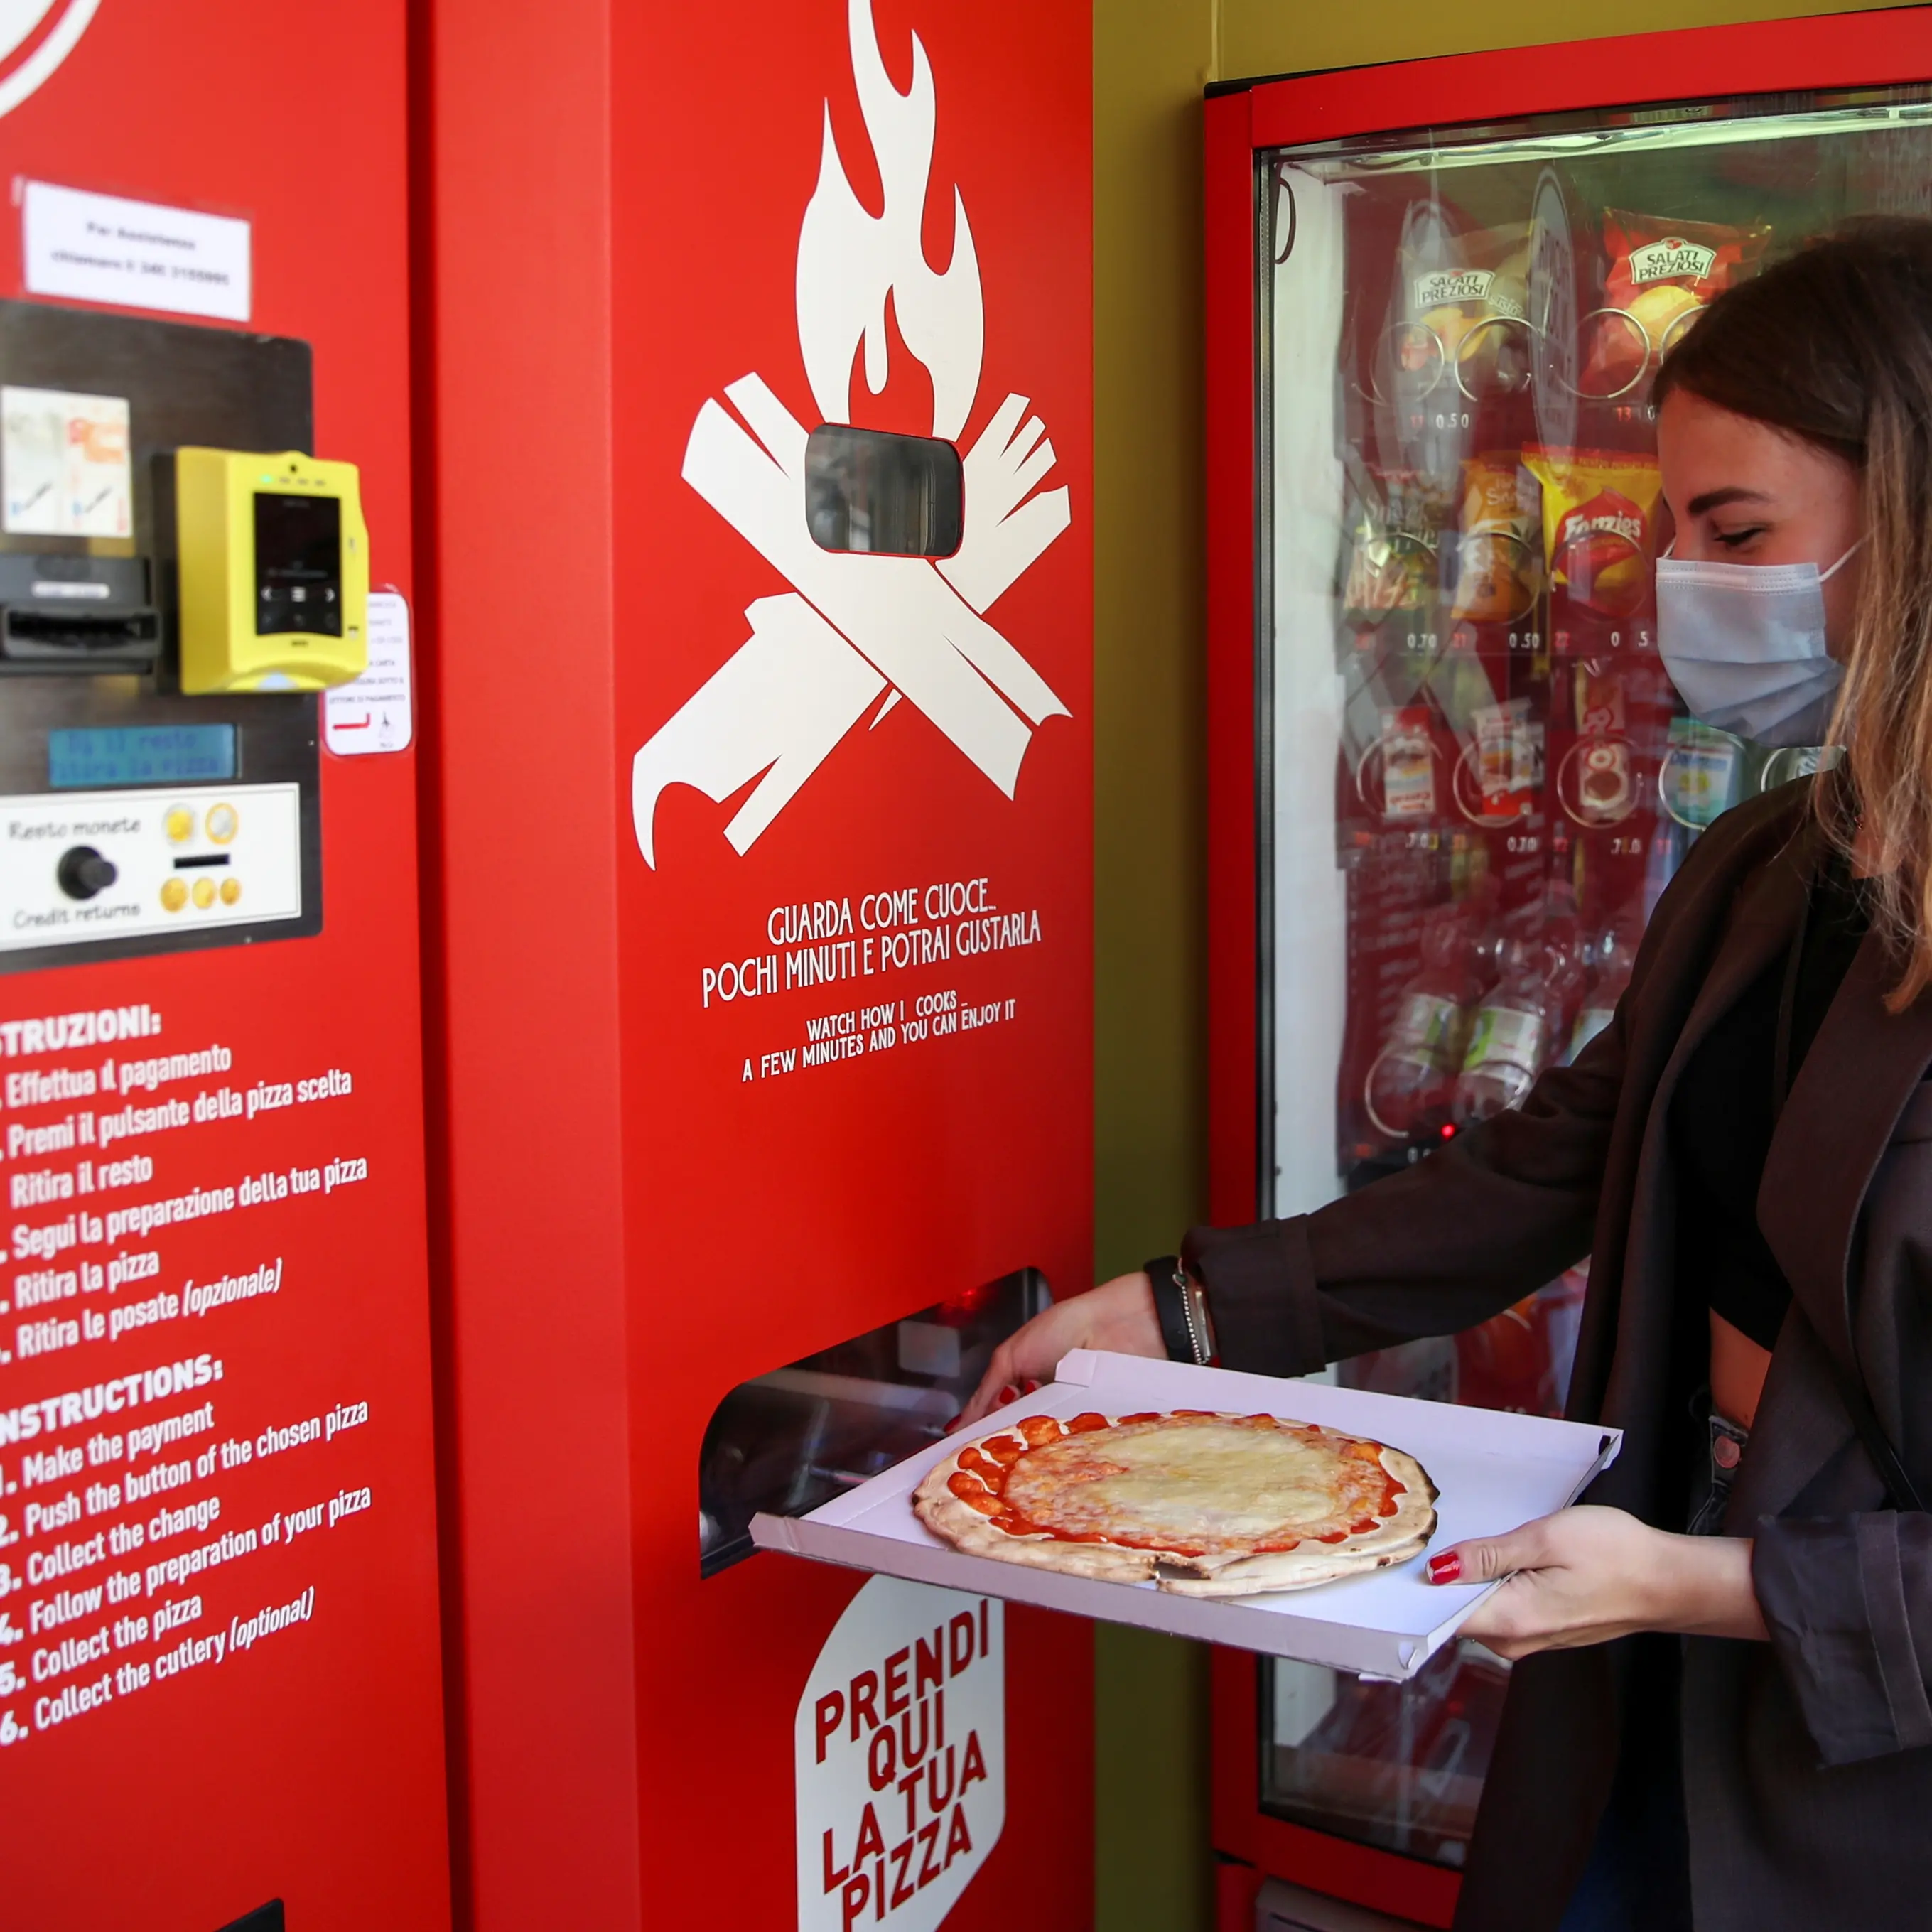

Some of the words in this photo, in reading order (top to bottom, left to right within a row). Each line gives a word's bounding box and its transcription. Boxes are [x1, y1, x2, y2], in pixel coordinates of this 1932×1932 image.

[1422, 284, 1484, 303] PREZIOSI
[1430, 275, 1478, 286] SALATI
[1639, 261, 1705, 279] PREZIOSI
[1647, 251, 1698, 265] SALATI
[1564, 510, 1641, 541] Fonzies
[9, 821, 68, 840] Resto
[72, 816, 141, 836] monete
[14, 907, 70, 929] Credit
[702, 954, 777, 1008] POCHI
[785, 940, 856, 990] MINUTI
[863, 938, 874, 975] E
[881, 925, 950, 972] POTRAI
[956, 910, 1041, 956] GUSTARLA
[767, 898, 853, 945] GUARDA
[860, 888, 919, 931] COME
[742, 1059, 753, 1082] A
[761, 1049, 797, 1079] FEW
[802, 1035, 864, 1069] MINUTES
[869, 1027, 896, 1052] AND
[901, 1020, 928, 1045] YOU
[933, 1012, 957, 1037] CAN
[961, 1003, 1002, 1030] ENJOY
[1005, 999, 1016, 1021] IT
[806, 1013, 856, 1042] WATCH
[861, 1003, 895, 1029] HOW
[915, 990, 957, 1018] COOKS
[6, 1068, 96, 1108] Effettua
[101, 1060, 116, 1091] il
[121, 1044, 232, 1096] pagamento
[7, 1116, 73, 1159] Premi
[79, 1111, 95, 1145] il
[100, 1098, 189, 1148] pulsante
[194, 1087, 242, 1123] della
[247, 1080, 293, 1119] pizza
[298, 1069, 352, 1103] scelta
[10, 1169, 72, 1209] Ritira
[78, 1163, 94, 1194] il
[100, 1155, 153, 1190] resto
[12, 1211, 76, 1261] Segui
[81, 1210, 101, 1243] la
[107, 1185, 234, 1246] preparazione
[239, 1174, 287, 1207] della
[291, 1168, 320, 1195] tua
[325, 1157, 367, 1195] pizza
[15, 1268, 77, 1310] Ritira
[82, 1262, 101, 1291] la
[109, 1250, 159, 1291] pizza
[16, 1317, 79, 1360] Ritira
[83, 1309, 105, 1339] le
[110, 1295, 178, 1342] posate
[183, 1257, 282, 1317] (opzionale)
[23, 1447, 83, 1487] Make
[87, 1435, 122, 1467] the
[128, 1401, 214, 1460] payment
[26, 1492, 80, 1538] Push
[85, 1482, 121, 1514] the
[126, 1461, 192, 1502] button
[196, 1446, 217, 1478] of
[221, 1438, 252, 1469] the
[257, 1417, 320, 1457] chosen
[325, 1401, 368, 1440] pizza
[0, 1612, 23, 1646] 4.
[30, 1587, 102, 1636] Follow
[107, 1570, 141, 1604] the
[146, 1529, 257, 1597] preparation
[261, 1513, 282, 1547] of
[284, 1502, 324, 1543] your
[329, 1486, 371, 1526] pizza
[27, 1538, 105, 1586] Collect
[109, 1521, 144, 1554] the
[149, 1496, 220, 1541] change
[0, 1661, 26, 1698] 5.
[32, 1633, 109, 1683] Collect
[114, 1616, 148, 1648] the
[153, 1594, 202, 1641] pizza
[0, 1710, 28, 1746] 6.
[35, 1681, 111, 1731] Collect
[117, 1664, 150, 1697] the
[156, 1631, 225, 1680] cutlery
[230, 1585, 314, 1653] (optional)
[815, 1598, 989, 1764] PRENDI
[868, 1688, 944, 1792] QUI
[823, 1801, 885, 1895] LA
[897, 1729, 986, 1835] TUA
[843, 1801, 973, 1932] PIZZA
